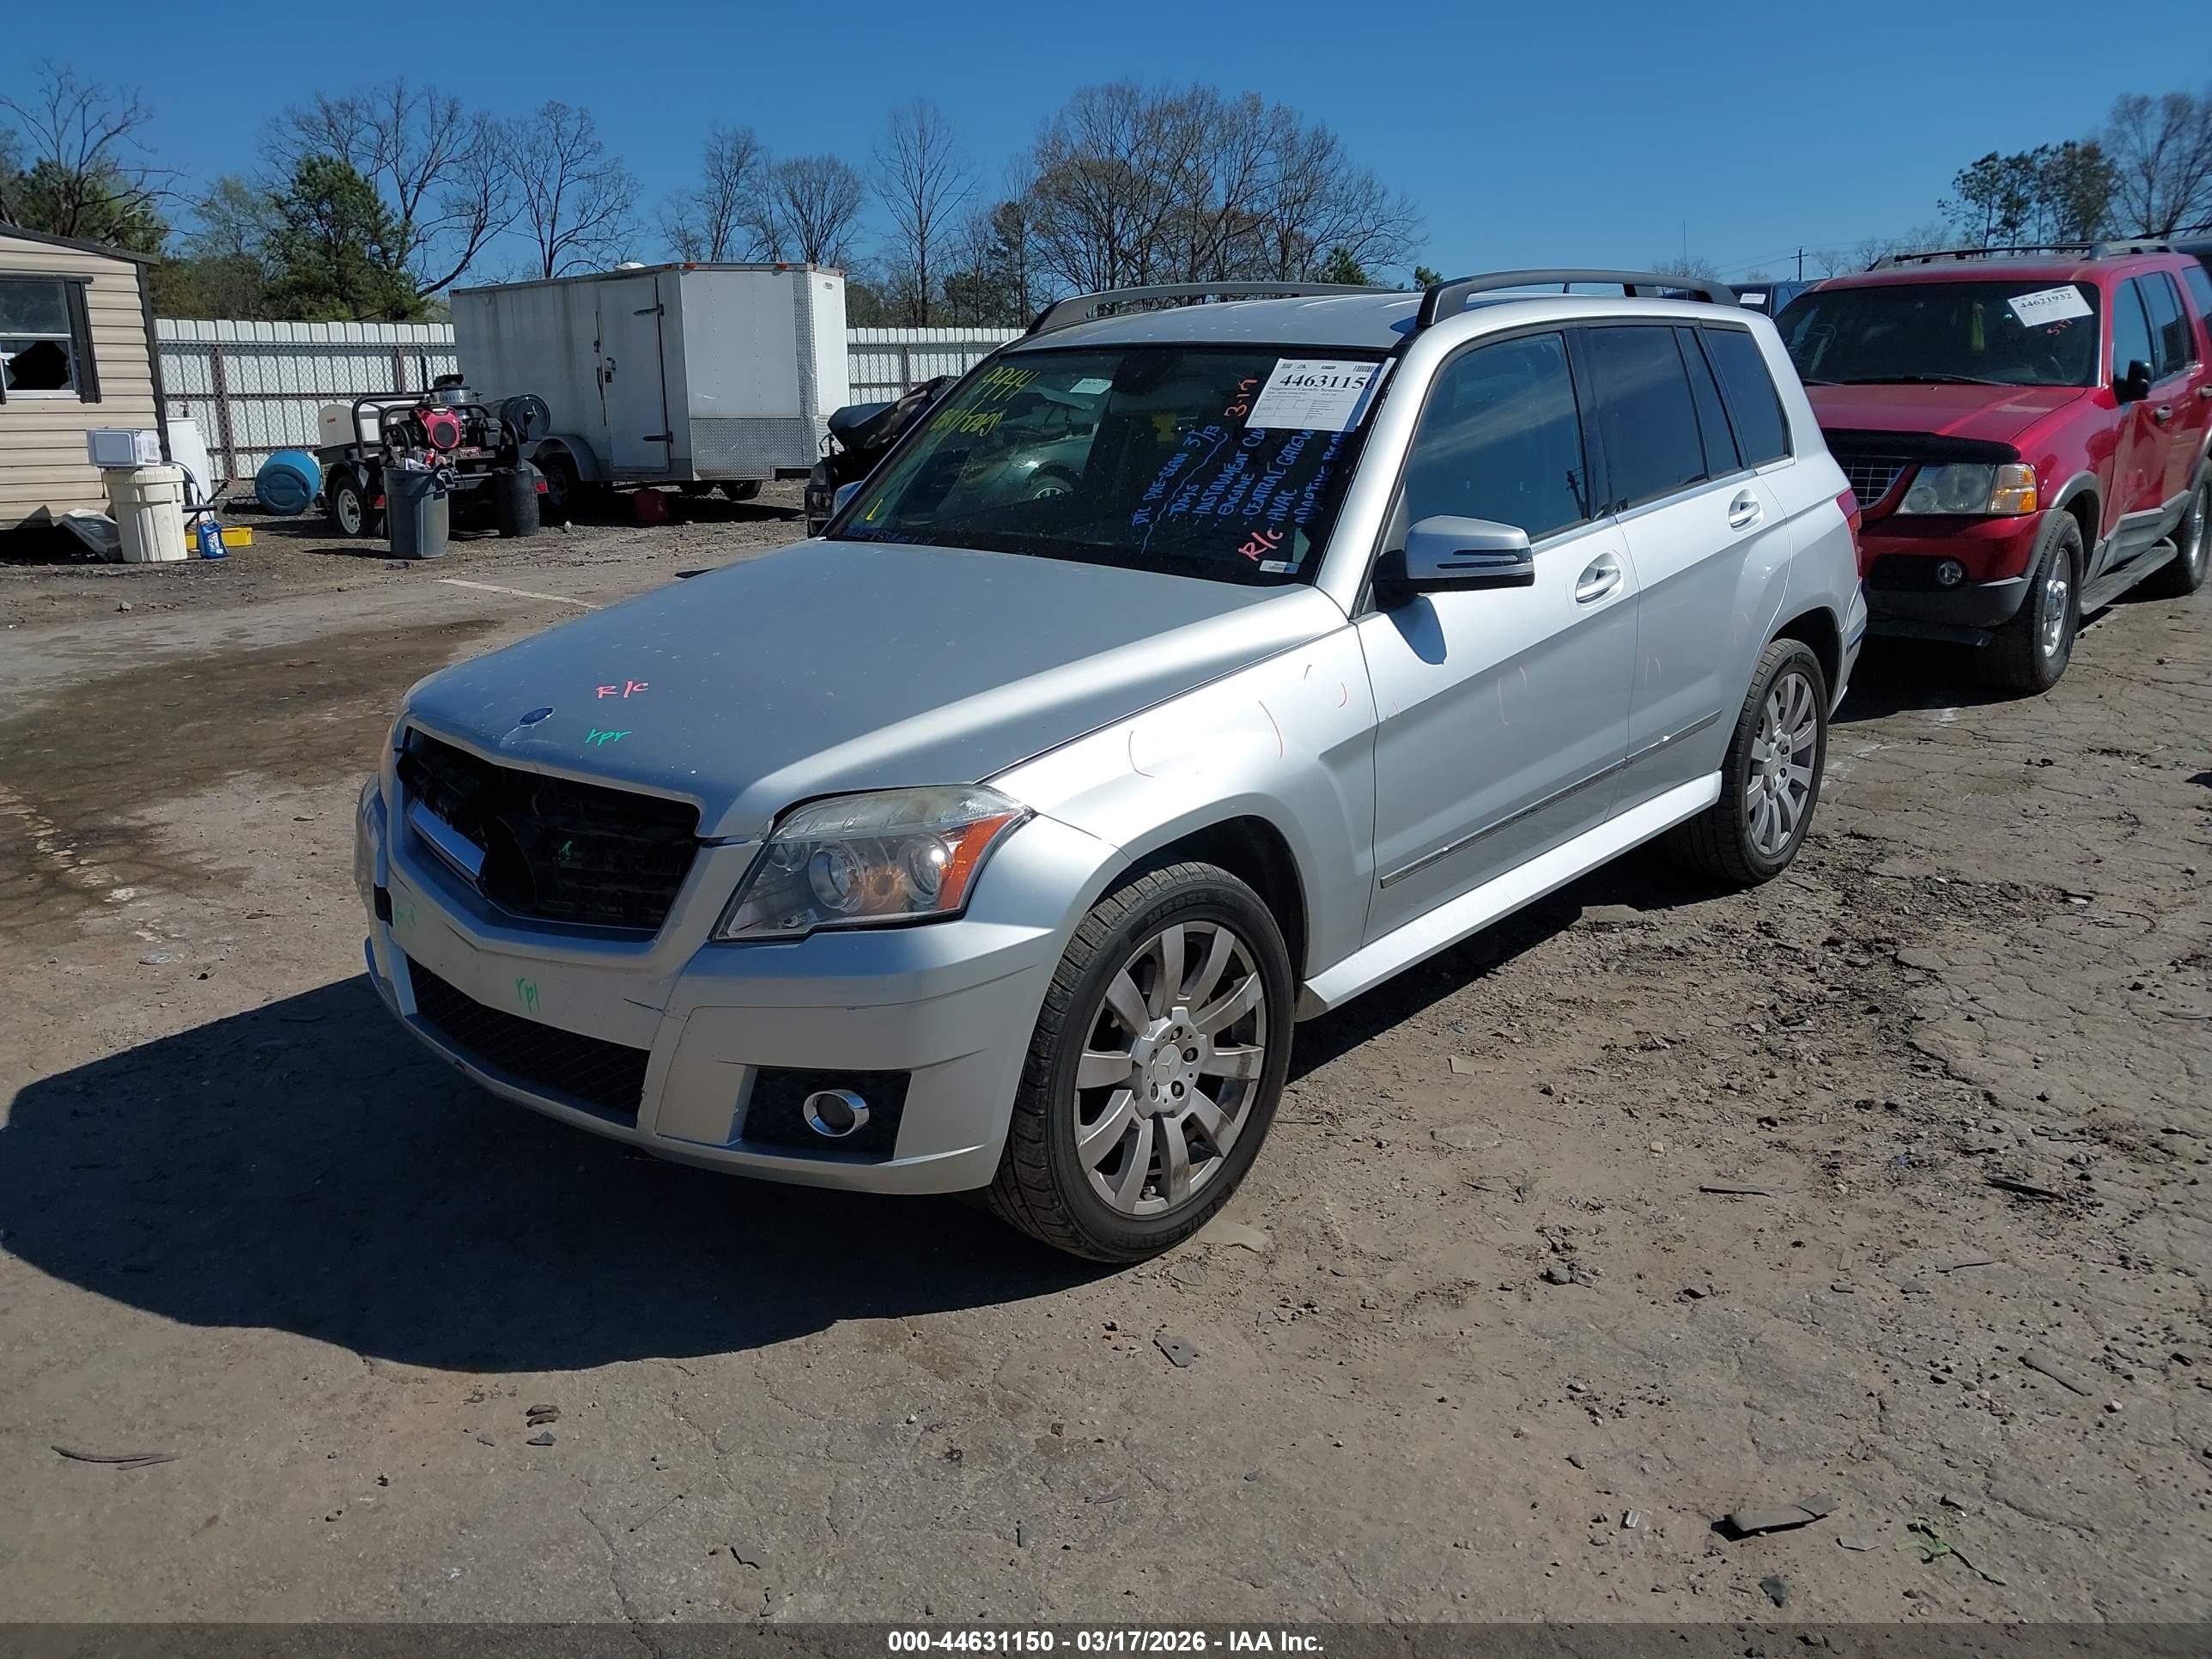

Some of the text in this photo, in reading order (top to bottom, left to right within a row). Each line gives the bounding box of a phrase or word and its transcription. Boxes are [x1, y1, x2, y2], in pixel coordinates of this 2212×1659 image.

[2021, 293, 2073, 308] 44621932
[1279, 374, 1376, 391] 44631150
[1218, 473, 1255, 516] ENGINE
[1242, 462, 1286, 516] CENTRAL
[1266, 489, 1298, 521] HVAC
